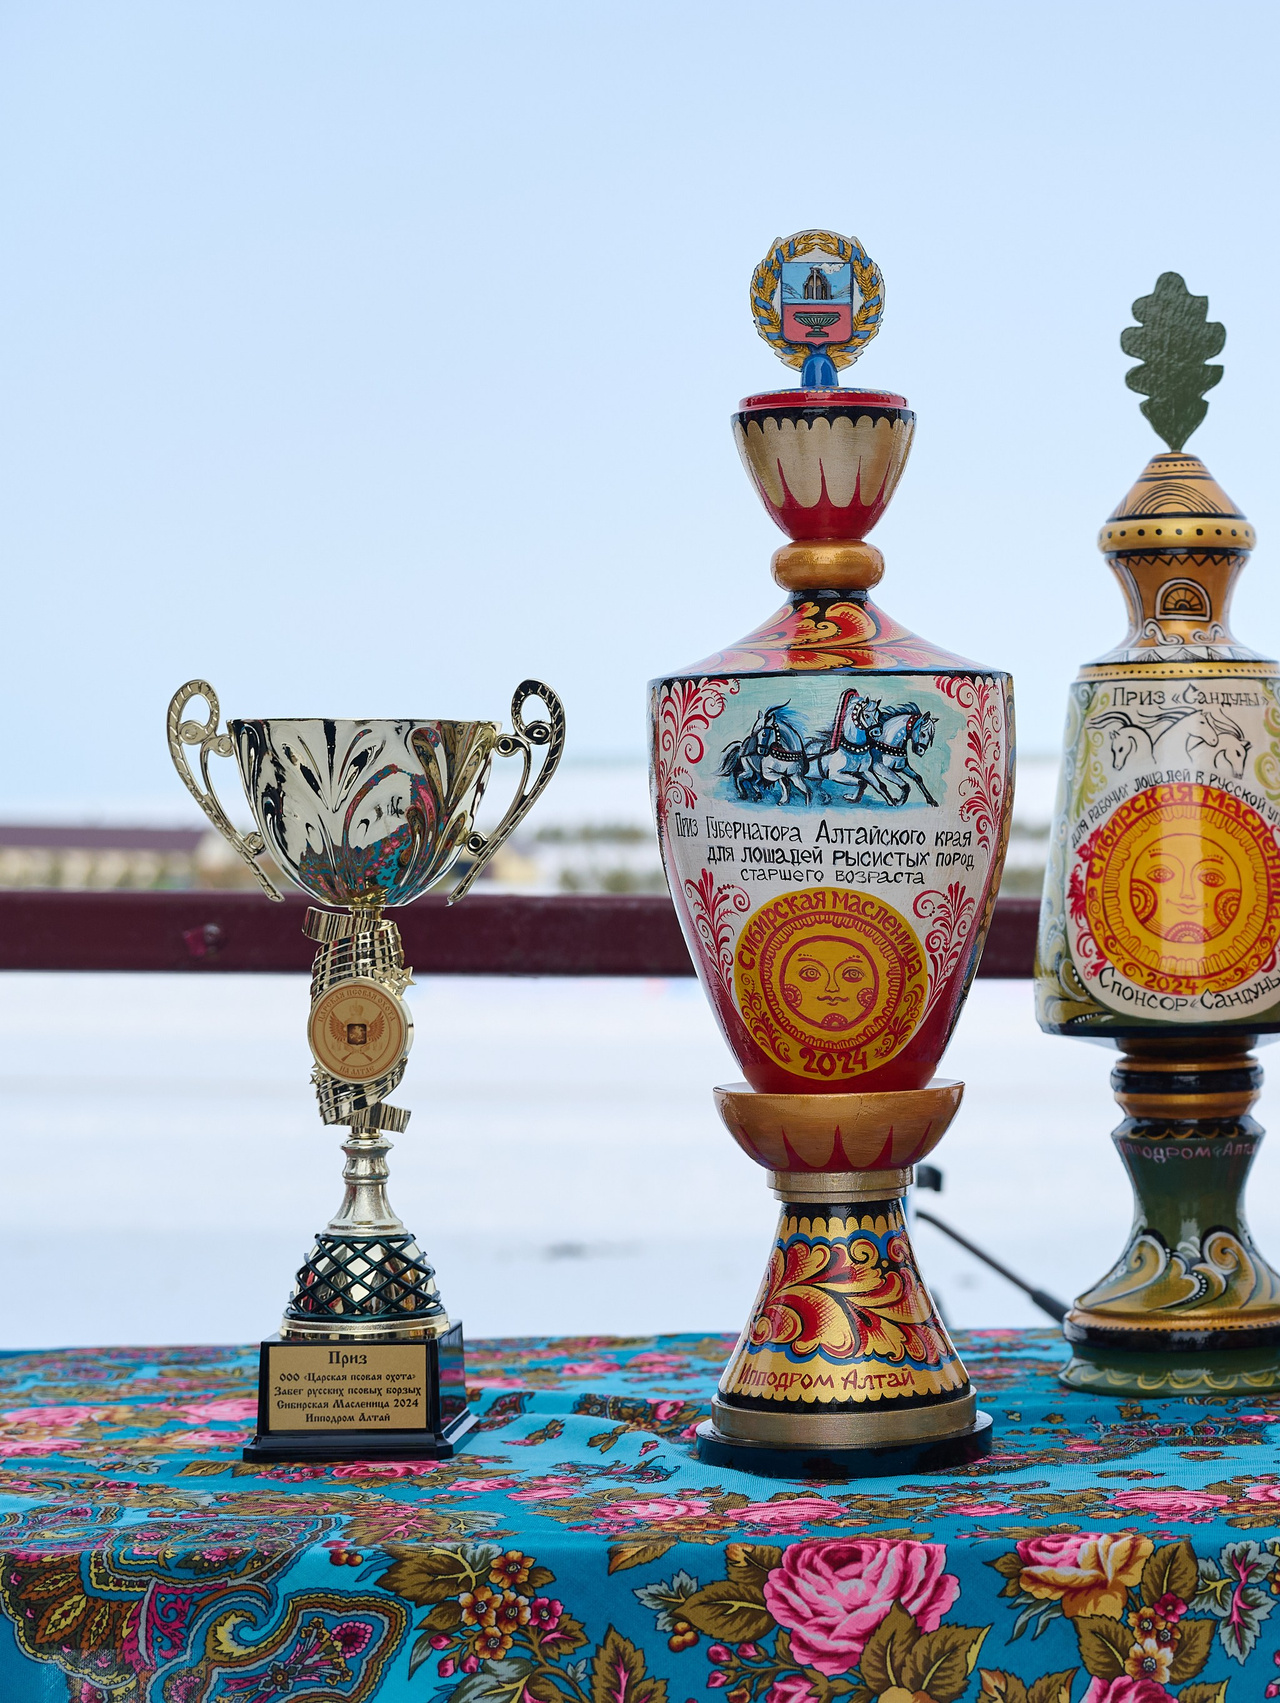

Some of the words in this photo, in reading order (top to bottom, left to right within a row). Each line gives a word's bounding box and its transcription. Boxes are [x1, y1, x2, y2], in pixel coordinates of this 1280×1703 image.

[675, 812, 699, 837] Приз
[706, 816, 802, 844] Губернатора
[816, 820, 926, 846] Алтайского
[1143, 974, 1199, 995] 2024
[800, 1049, 868, 1077] 2024
[328, 1351, 368, 1367] Приз
[280, 1373, 300, 1382] ООО
[350, 1373, 382, 1382] псовая
[737, 1363, 835, 1392] Ипподром
[841, 1367, 915, 1391] Алтай
[274, 1386, 304, 1396] Забег
[307, 1387, 344, 1398] русских
[347, 1387, 383, 1396] псовых
[386, 1387, 422, 1397] борзых
[277, 1399, 329, 1411] Сибирская
[332, 1399, 390, 1410] Масленица
[393, 1398, 419, 1408] 2024
[305, 1413, 355, 1424] Ипподром
[358, 1413, 391, 1422] Алтай
